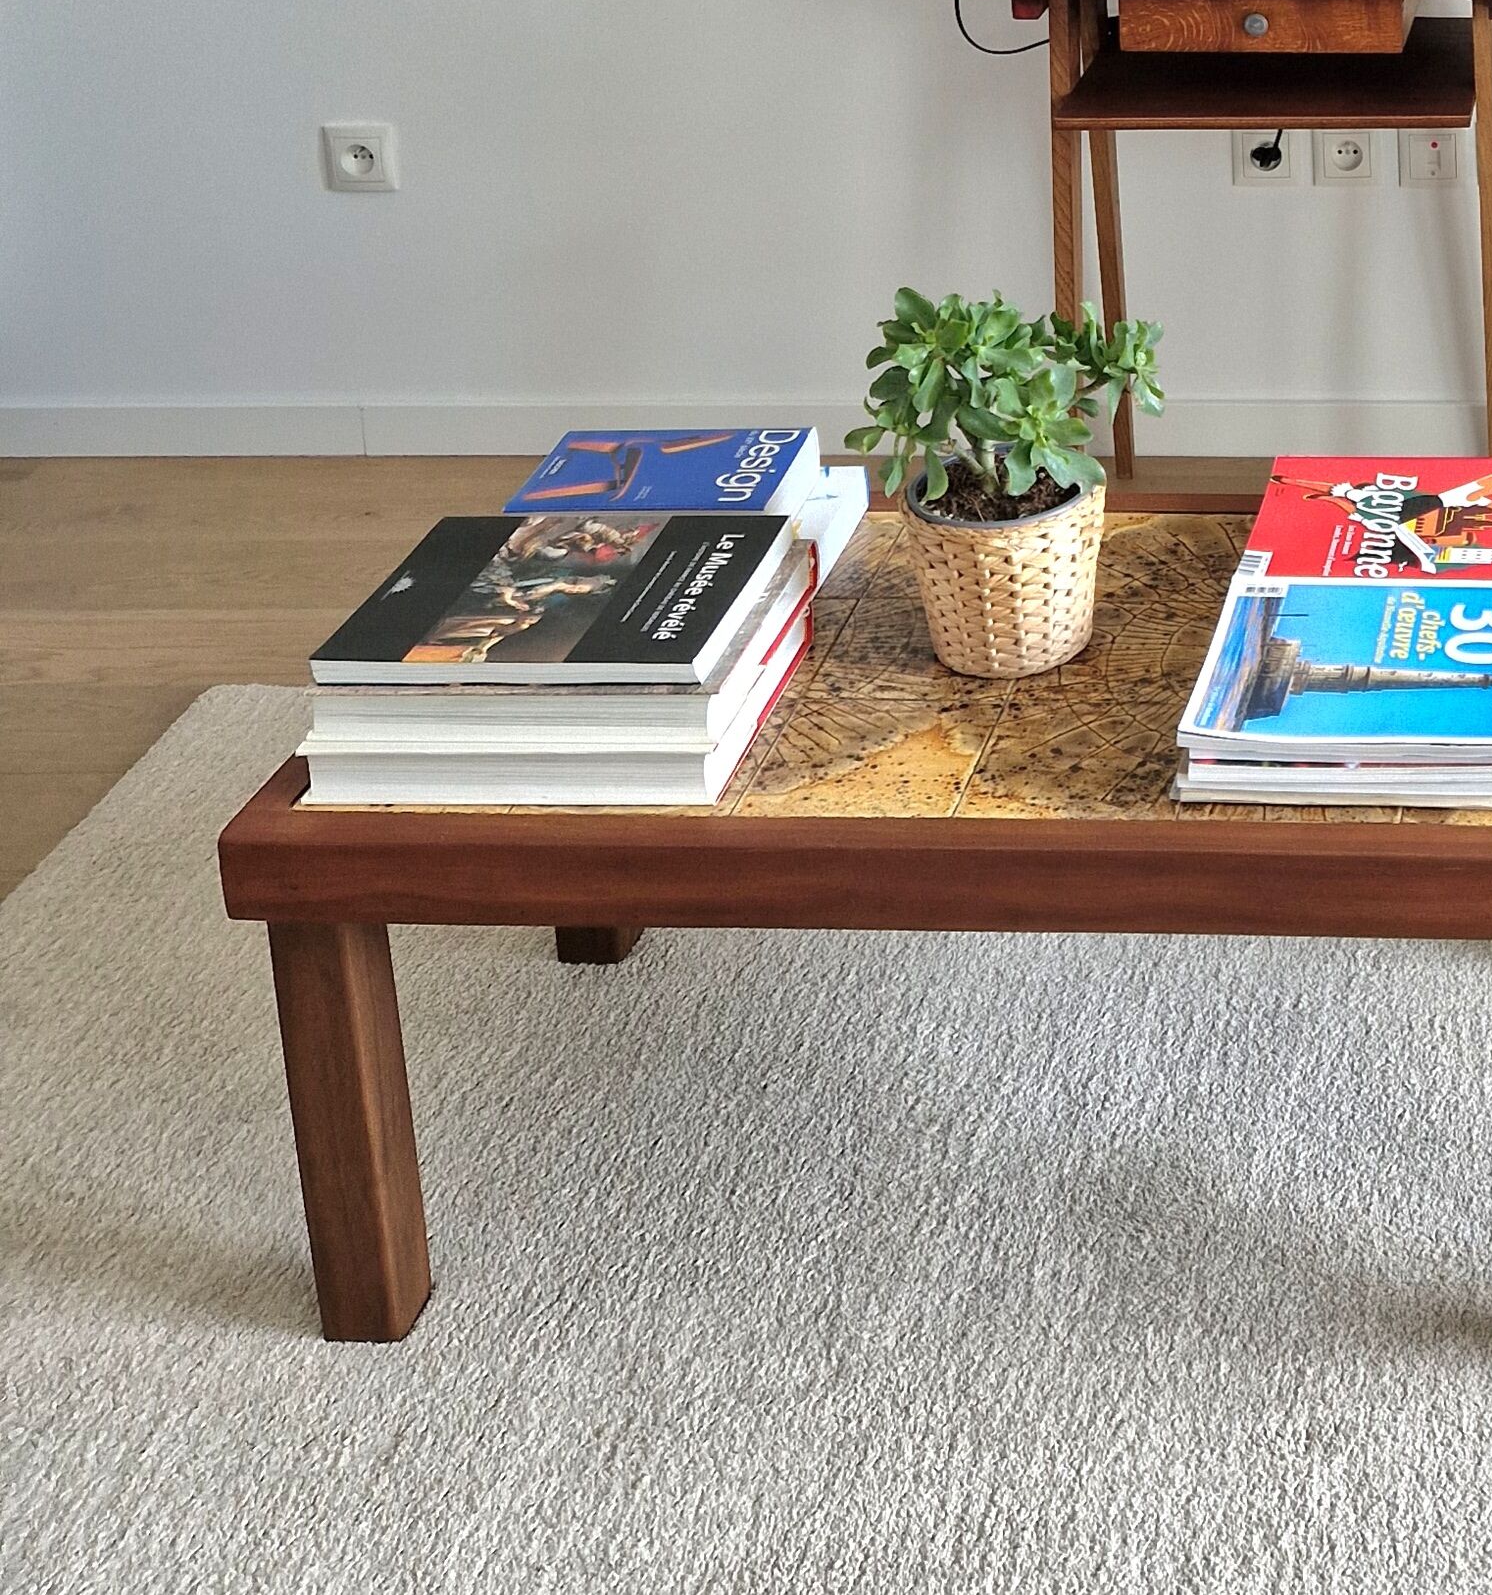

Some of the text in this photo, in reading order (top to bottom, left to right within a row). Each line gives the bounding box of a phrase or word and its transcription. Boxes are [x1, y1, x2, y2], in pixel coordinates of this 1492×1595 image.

[715, 429, 800, 502] Design
[716, 533, 745, 550] Le
[1353, 472, 1418, 579] Bayonne
[683, 552, 733, 596] Musée
[652, 598, 697, 640] révélé
